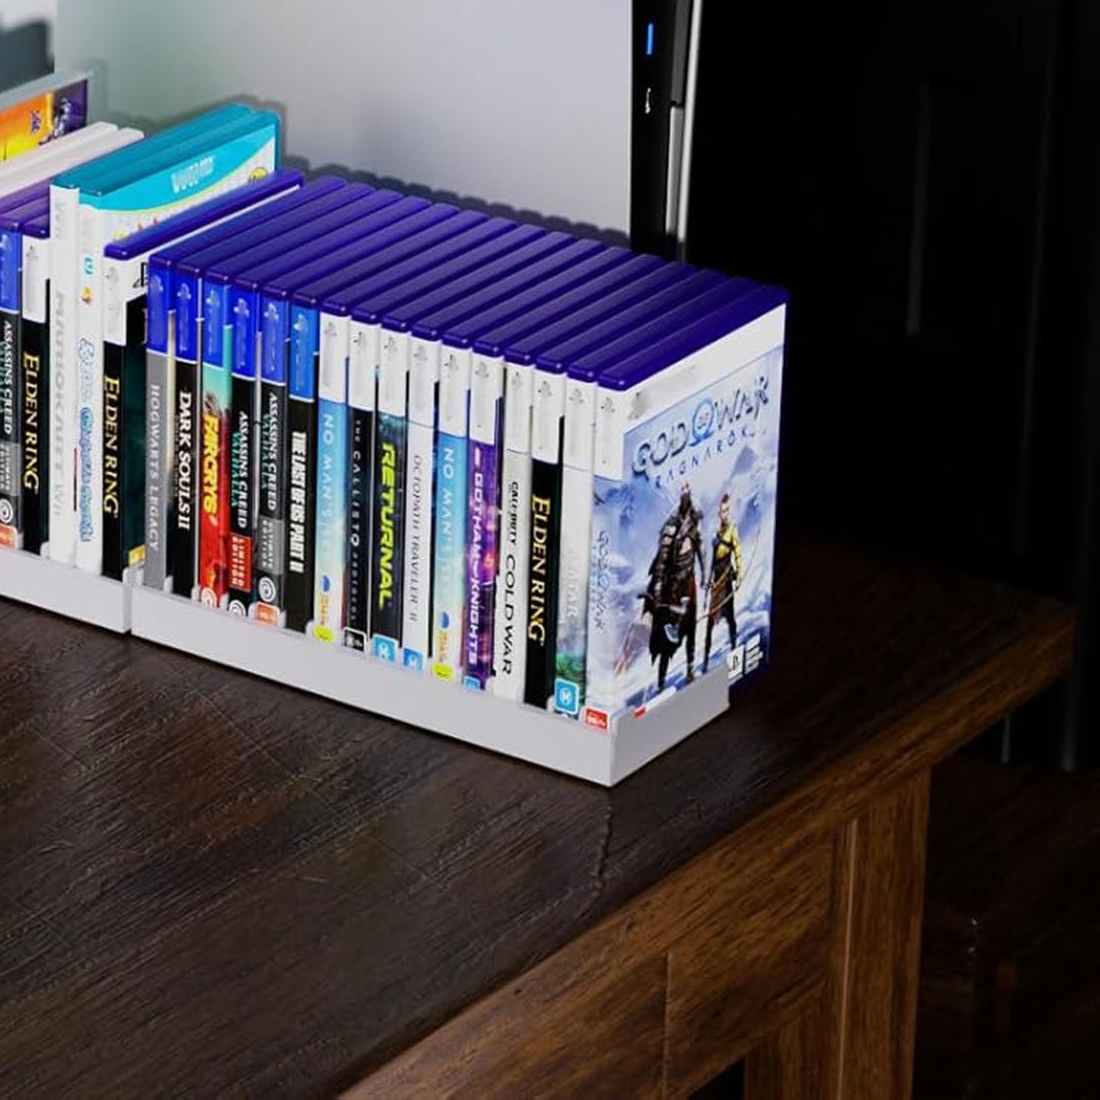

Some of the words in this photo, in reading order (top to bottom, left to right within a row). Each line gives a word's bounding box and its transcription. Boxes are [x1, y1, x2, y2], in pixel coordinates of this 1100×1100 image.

[3, 388, 13, 434] CREED
[24, 352, 40, 426] ELDEN
[103, 376, 119, 454] ELDEN
[178, 390, 192, 447] DARK
[149, 384, 161, 479] HOGWARTS
[291, 431, 306, 455] THE
[322, 413, 334, 443] NO
[632, 422, 688, 482] GOD
[24, 431, 40, 490] RING
[103, 459, 119, 512] RING
[178, 451, 192, 513] SOULS
[267, 463, 277, 511] CREED
[291, 455, 306, 488] LAST
[443, 447, 455, 478] NO
[148, 485, 160, 550] LEGACY
[237, 480, 248, 528] CREED
[350, 450, 362, 547] CALLISTO
[412, 455, 423, 529] OCTOPATH
[470, 472, 483, 560] GOTHAM
[290, 523, 305, 560] PART
[379, 442, 396, 610] RETURNAL
[529, 496, 551, 577] ELDEN
[410, 535, 421, 604] TRAVELER
[504, 554, 516, 620] COLD
[468, 578, 480, 665] KNIGHTS
[527, 582, 546, 641] RING
[502, 626, 513, 675] WAR
